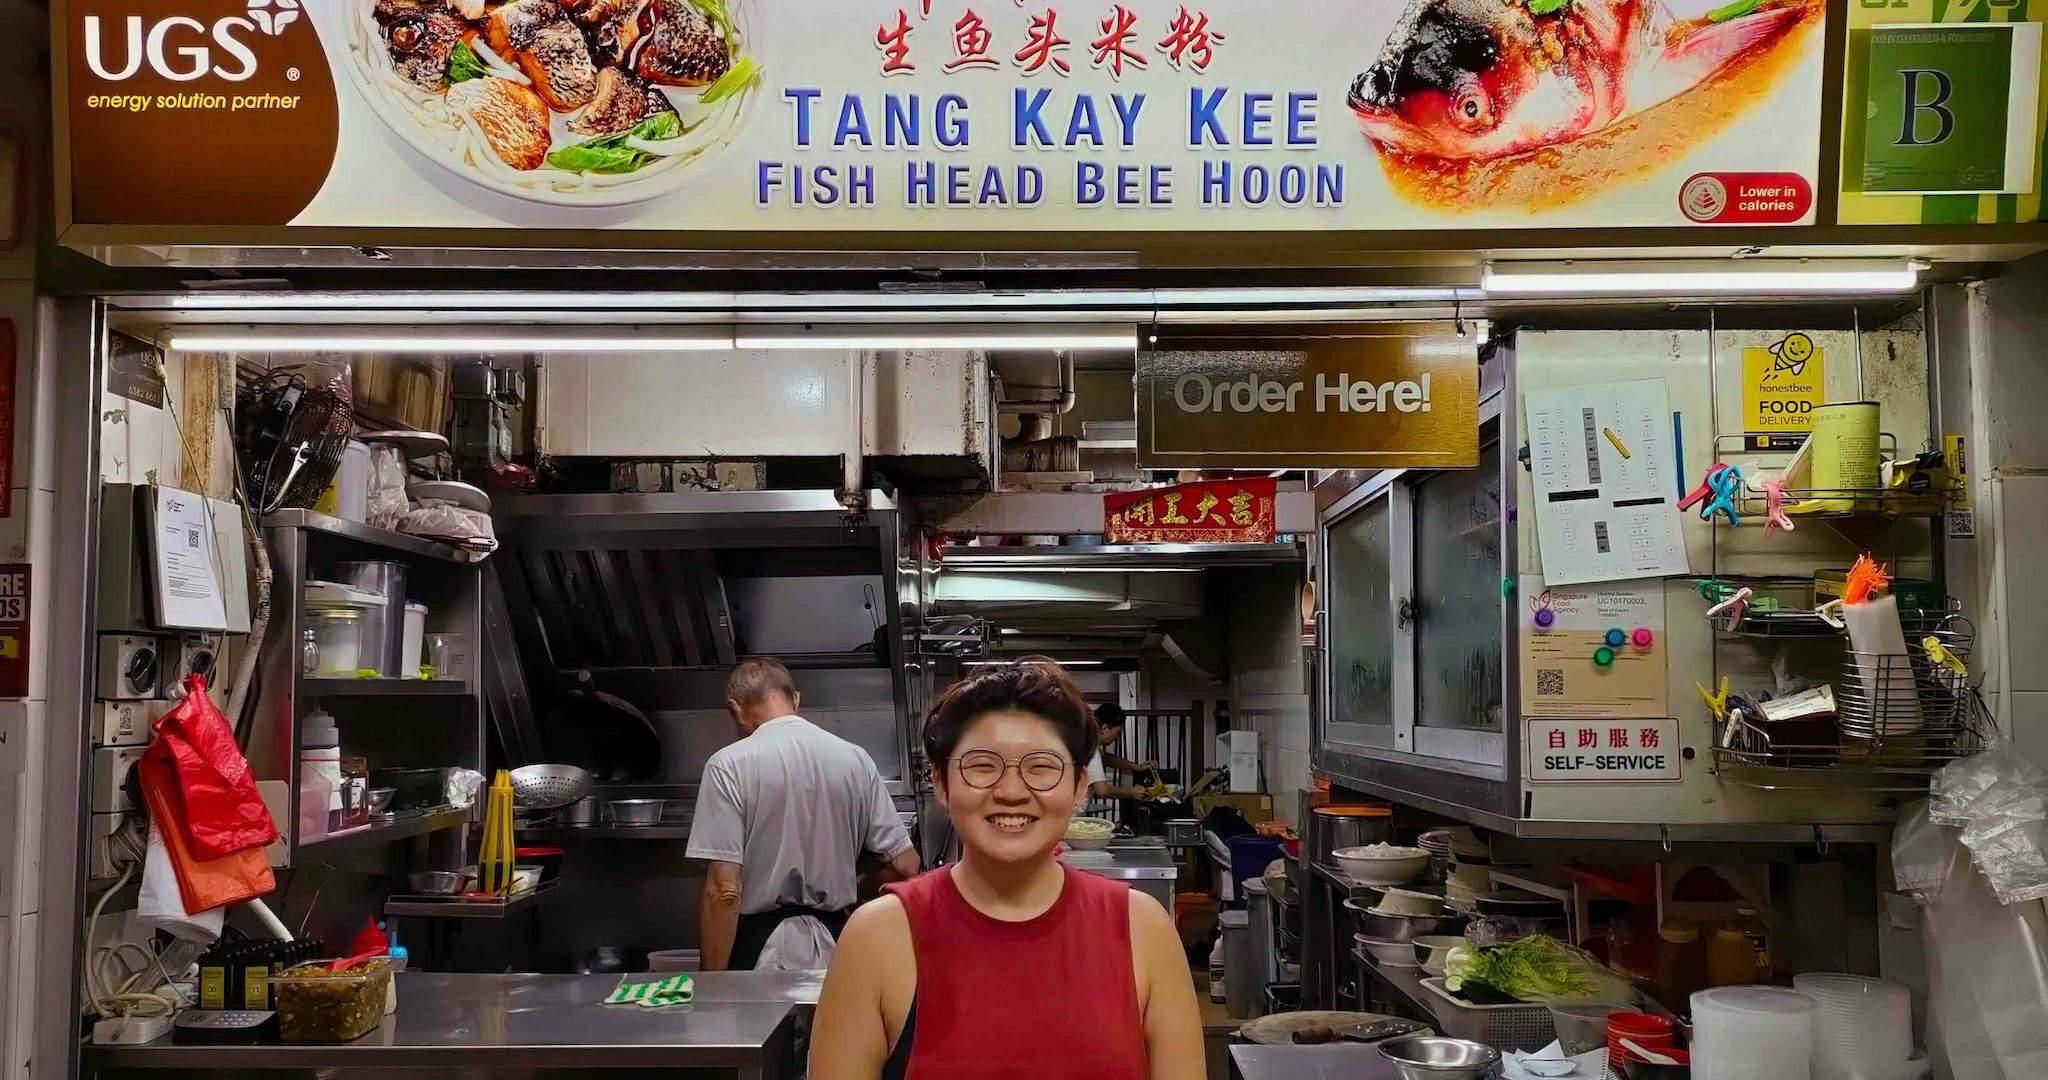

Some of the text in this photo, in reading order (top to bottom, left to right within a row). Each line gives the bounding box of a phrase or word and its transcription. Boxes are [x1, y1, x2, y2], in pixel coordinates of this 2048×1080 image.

[84, 15, 258, 81] UGS
[877, 4, 1226, 77] 生鱼头米粉
[87, 93, 301, 112] energy solution partner
[1892, 69, 1955, 146] B
[784, 86, 1319, 146] TANG KAY KEE
[757, 160, 1344, 204] FISH HEAD BEE HOON
[1739, 186, 1796, 197] Lower in
[1738, 200, 1795, 211] calories
[1173, 372, 1432, 413] Order Here!
[1759, 383, 1812, 393] honestbee
[1759, 400, 1812, 414] FOOD
[1759, 416, 1812, 425] DELIVERY
[1552, 592, 1588, 601] Singapore
[1552, 606, 1580, 614] Agency
[1549, 728, 1659, 748] 自助服務
[1544, 755, 1665, 770] SELF-SERVICE
